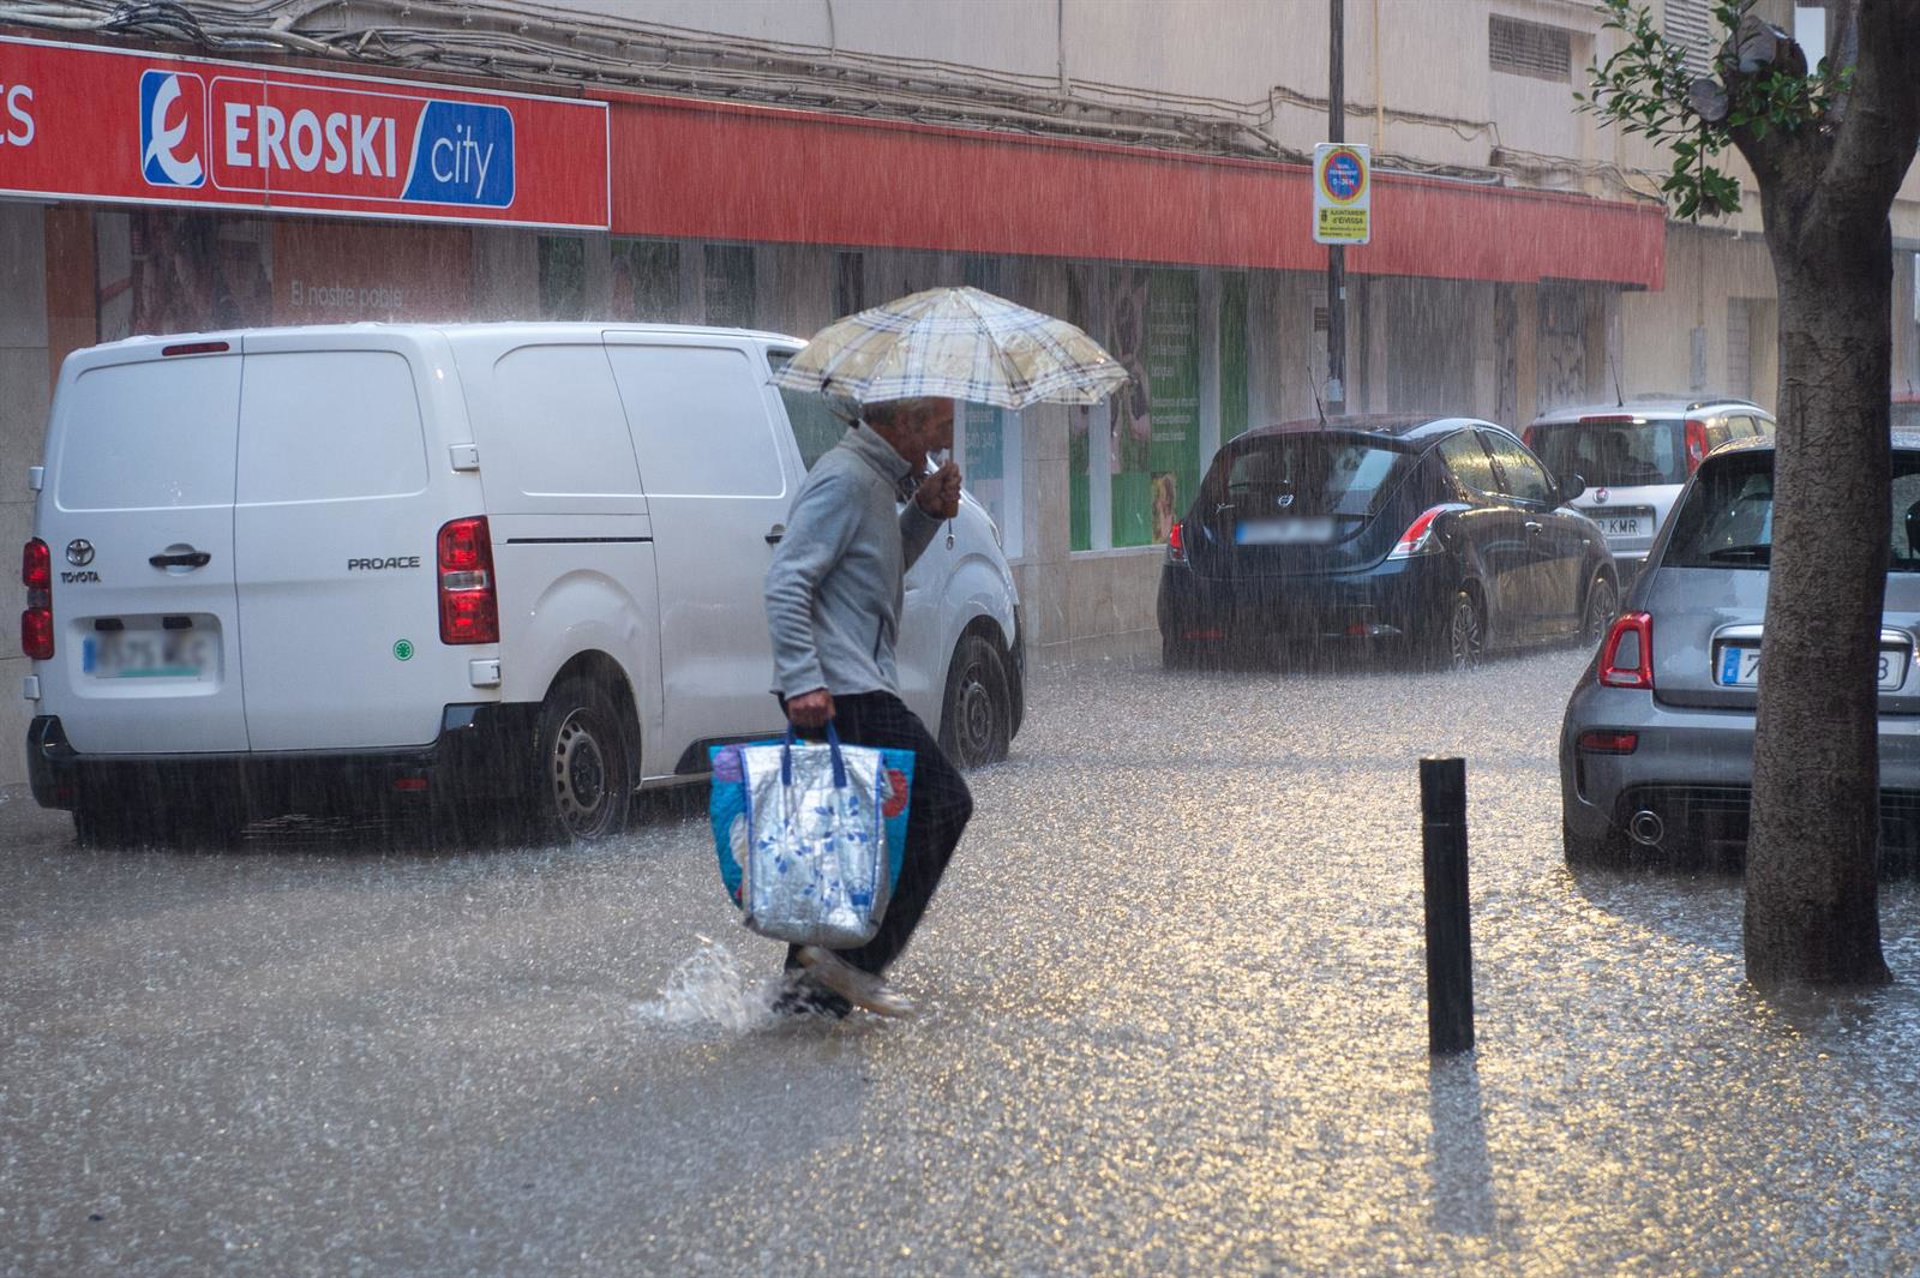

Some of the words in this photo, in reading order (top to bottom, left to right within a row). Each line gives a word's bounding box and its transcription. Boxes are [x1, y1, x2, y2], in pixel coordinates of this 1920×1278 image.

[223, 101, 397, 178] EROSKI
[431, 124, 494, 199] city
[1609, 519, 1638, 533] KMR
[347, 556, 421, 571] PROACE
[60, 571, 101, 584] TOYOTA
